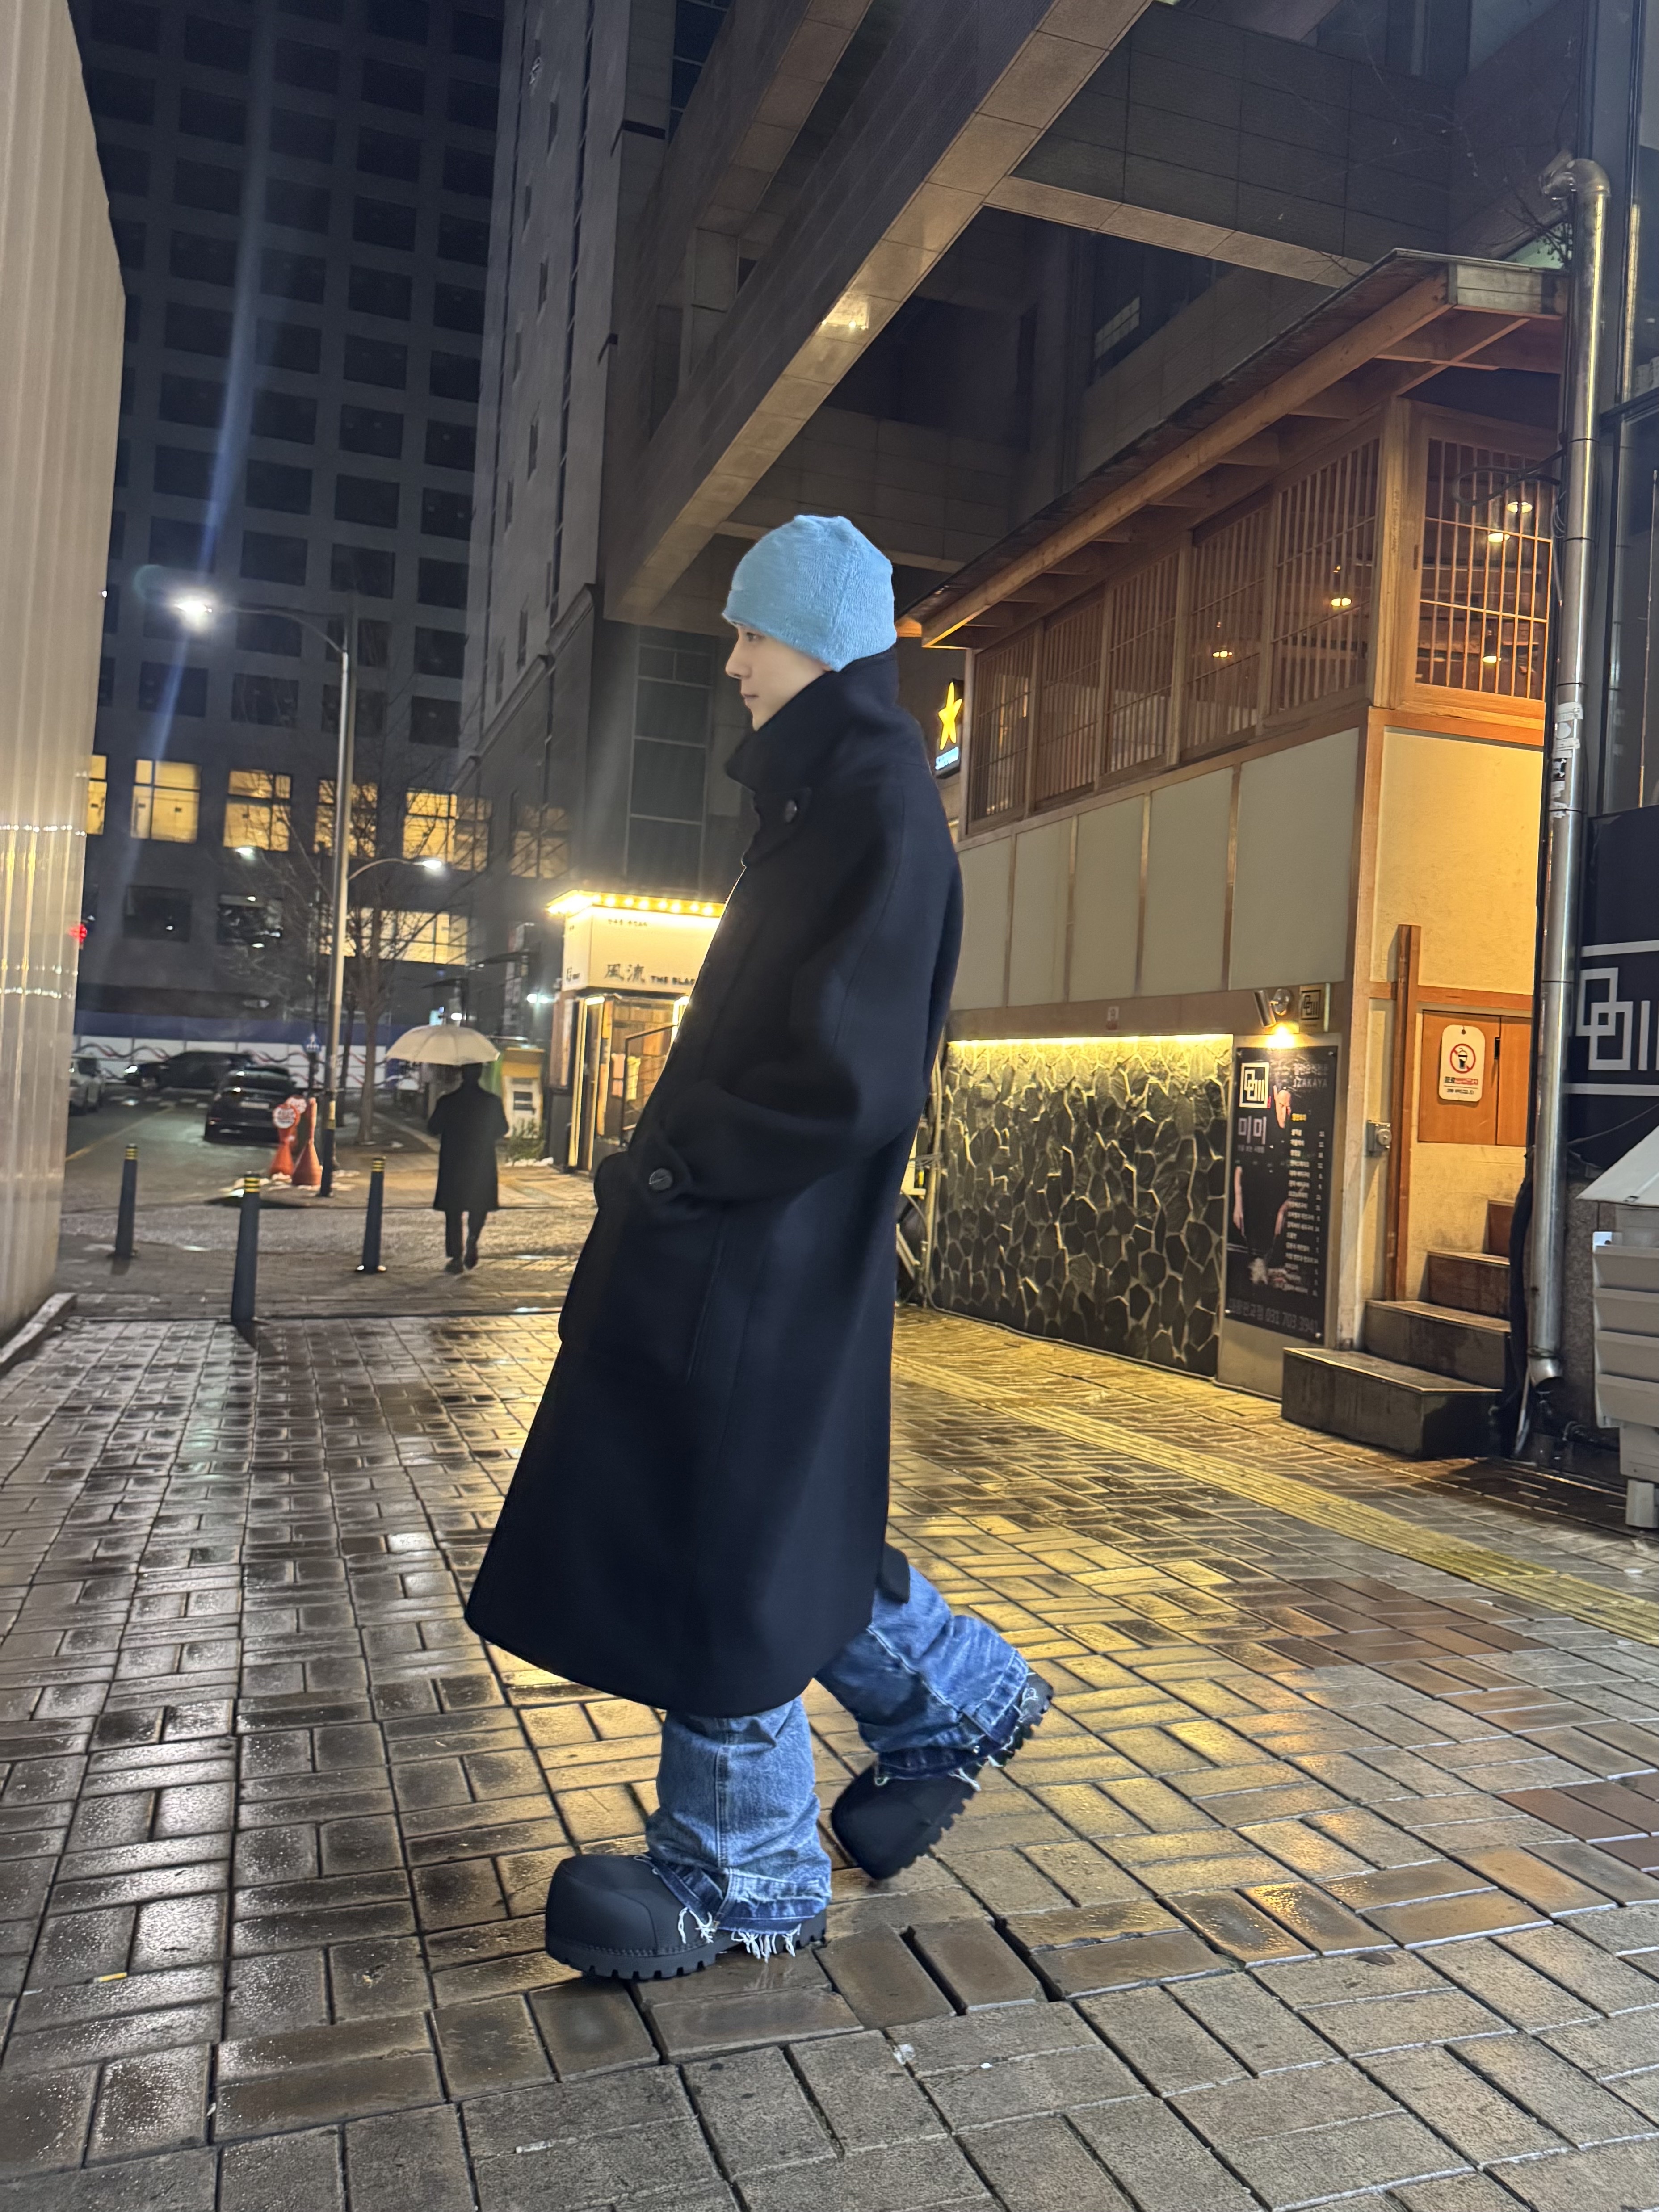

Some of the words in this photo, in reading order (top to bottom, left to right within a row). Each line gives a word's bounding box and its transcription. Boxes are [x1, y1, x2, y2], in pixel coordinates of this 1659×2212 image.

[605, 964, 645, 983] 風流
[651, 975, 668, 984] THE
[1292, 1078, 1327, 1088] IZAKAYA
[1238, 1116, 1267, 1145] 미미
